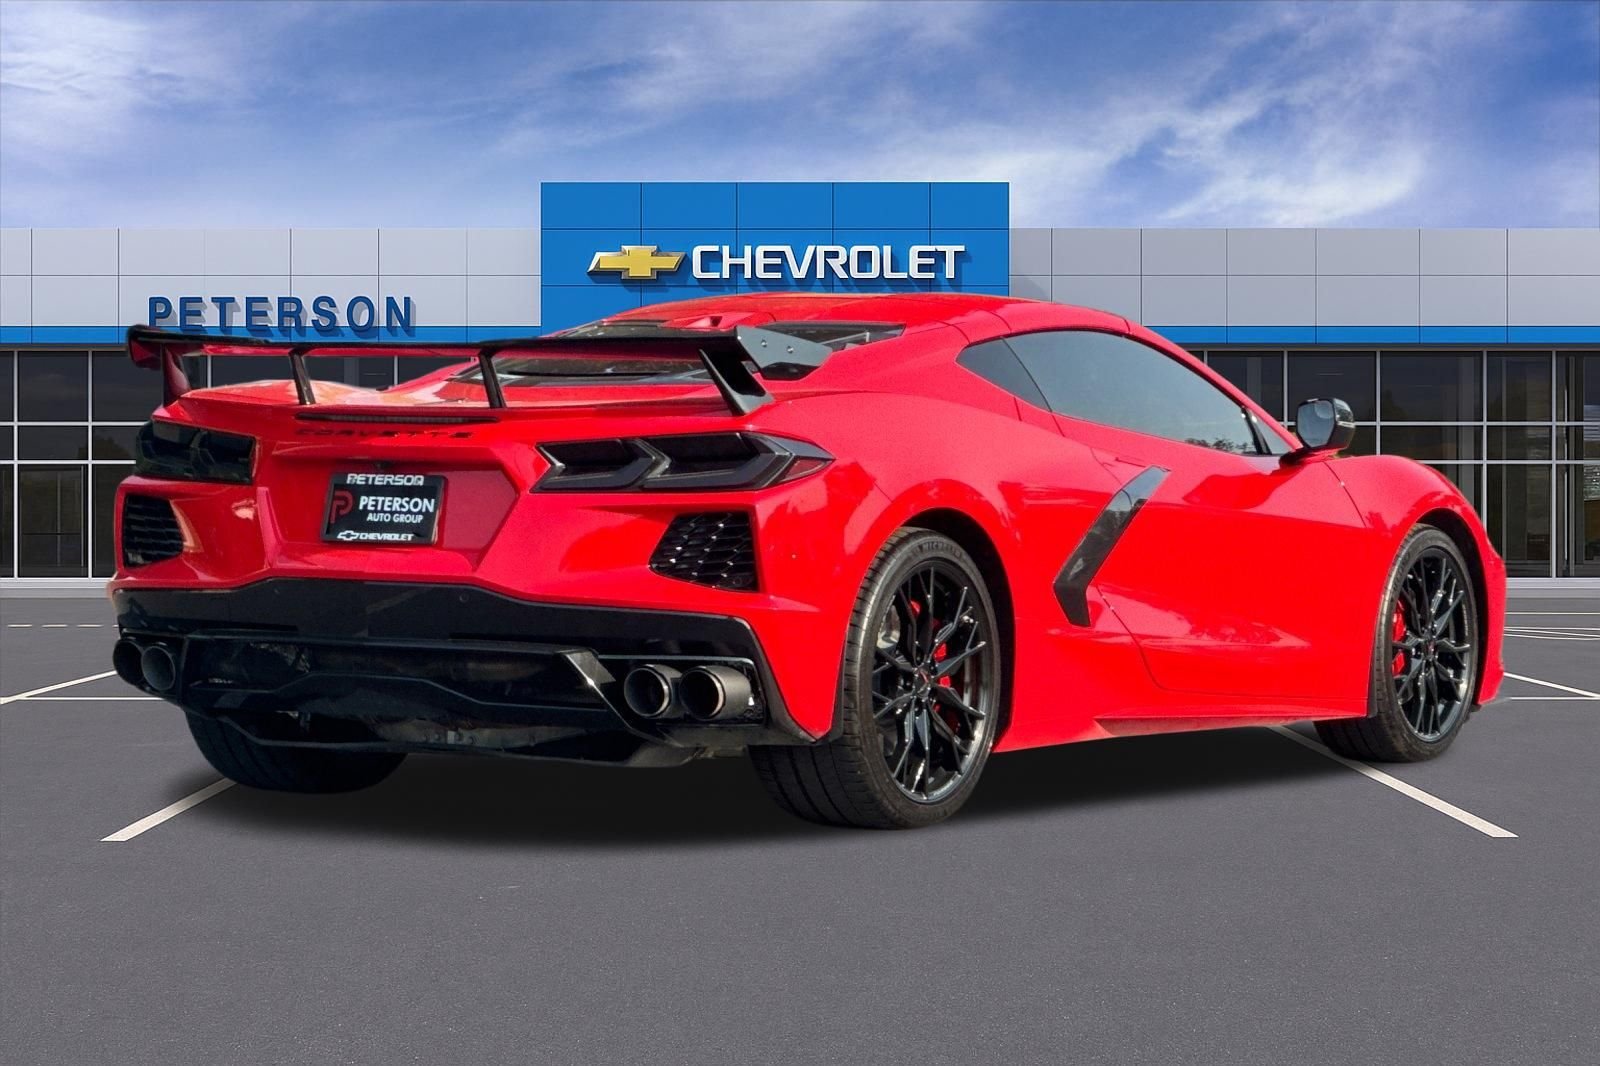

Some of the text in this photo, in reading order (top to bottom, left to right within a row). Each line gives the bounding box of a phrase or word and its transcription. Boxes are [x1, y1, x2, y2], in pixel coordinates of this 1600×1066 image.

[692, 245, 965, 279] CHEVROLET
[148, 296, 411, 332] PETERSON
[358, 495, 435, 513] PETERSON
[366, 513, 424, 524] AUTO GROUP
[359, 532, 415, 541] CHEVROLET
